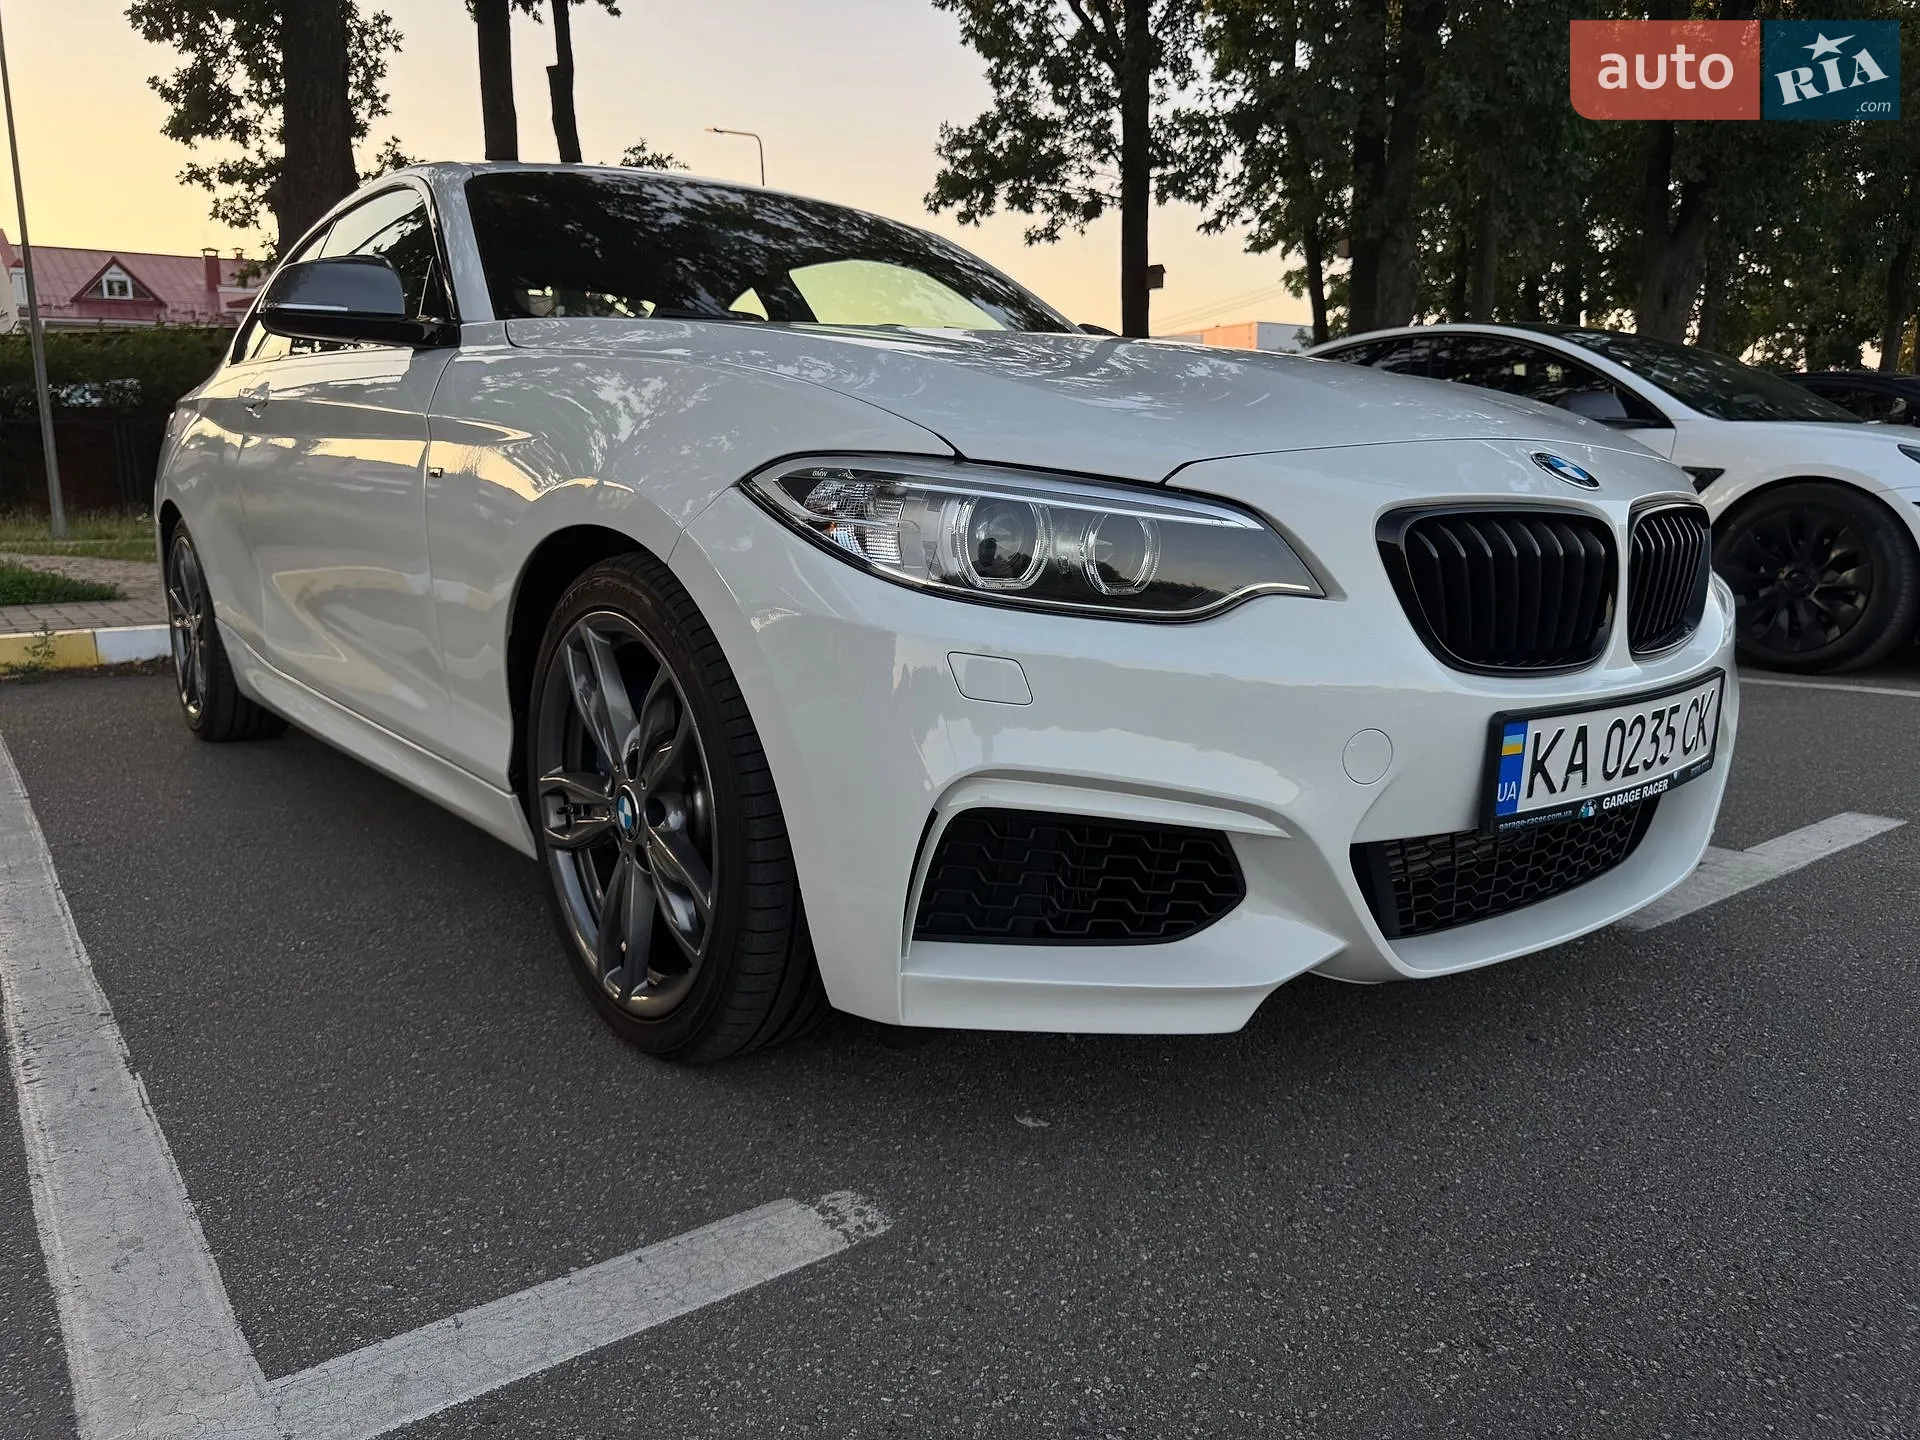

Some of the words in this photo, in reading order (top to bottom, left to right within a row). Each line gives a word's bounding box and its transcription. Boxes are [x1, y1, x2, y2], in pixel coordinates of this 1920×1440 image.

[1527, 723, 1588, 799] KA
[1602, 703, 1681, 782] 0235
[1682, 688, 1715, 756] CK
[1497, 781, 1517, 802] UA
[1602, 787, 1641, 811] GARAGE
[1642, 778, 1668, 799] RACER
